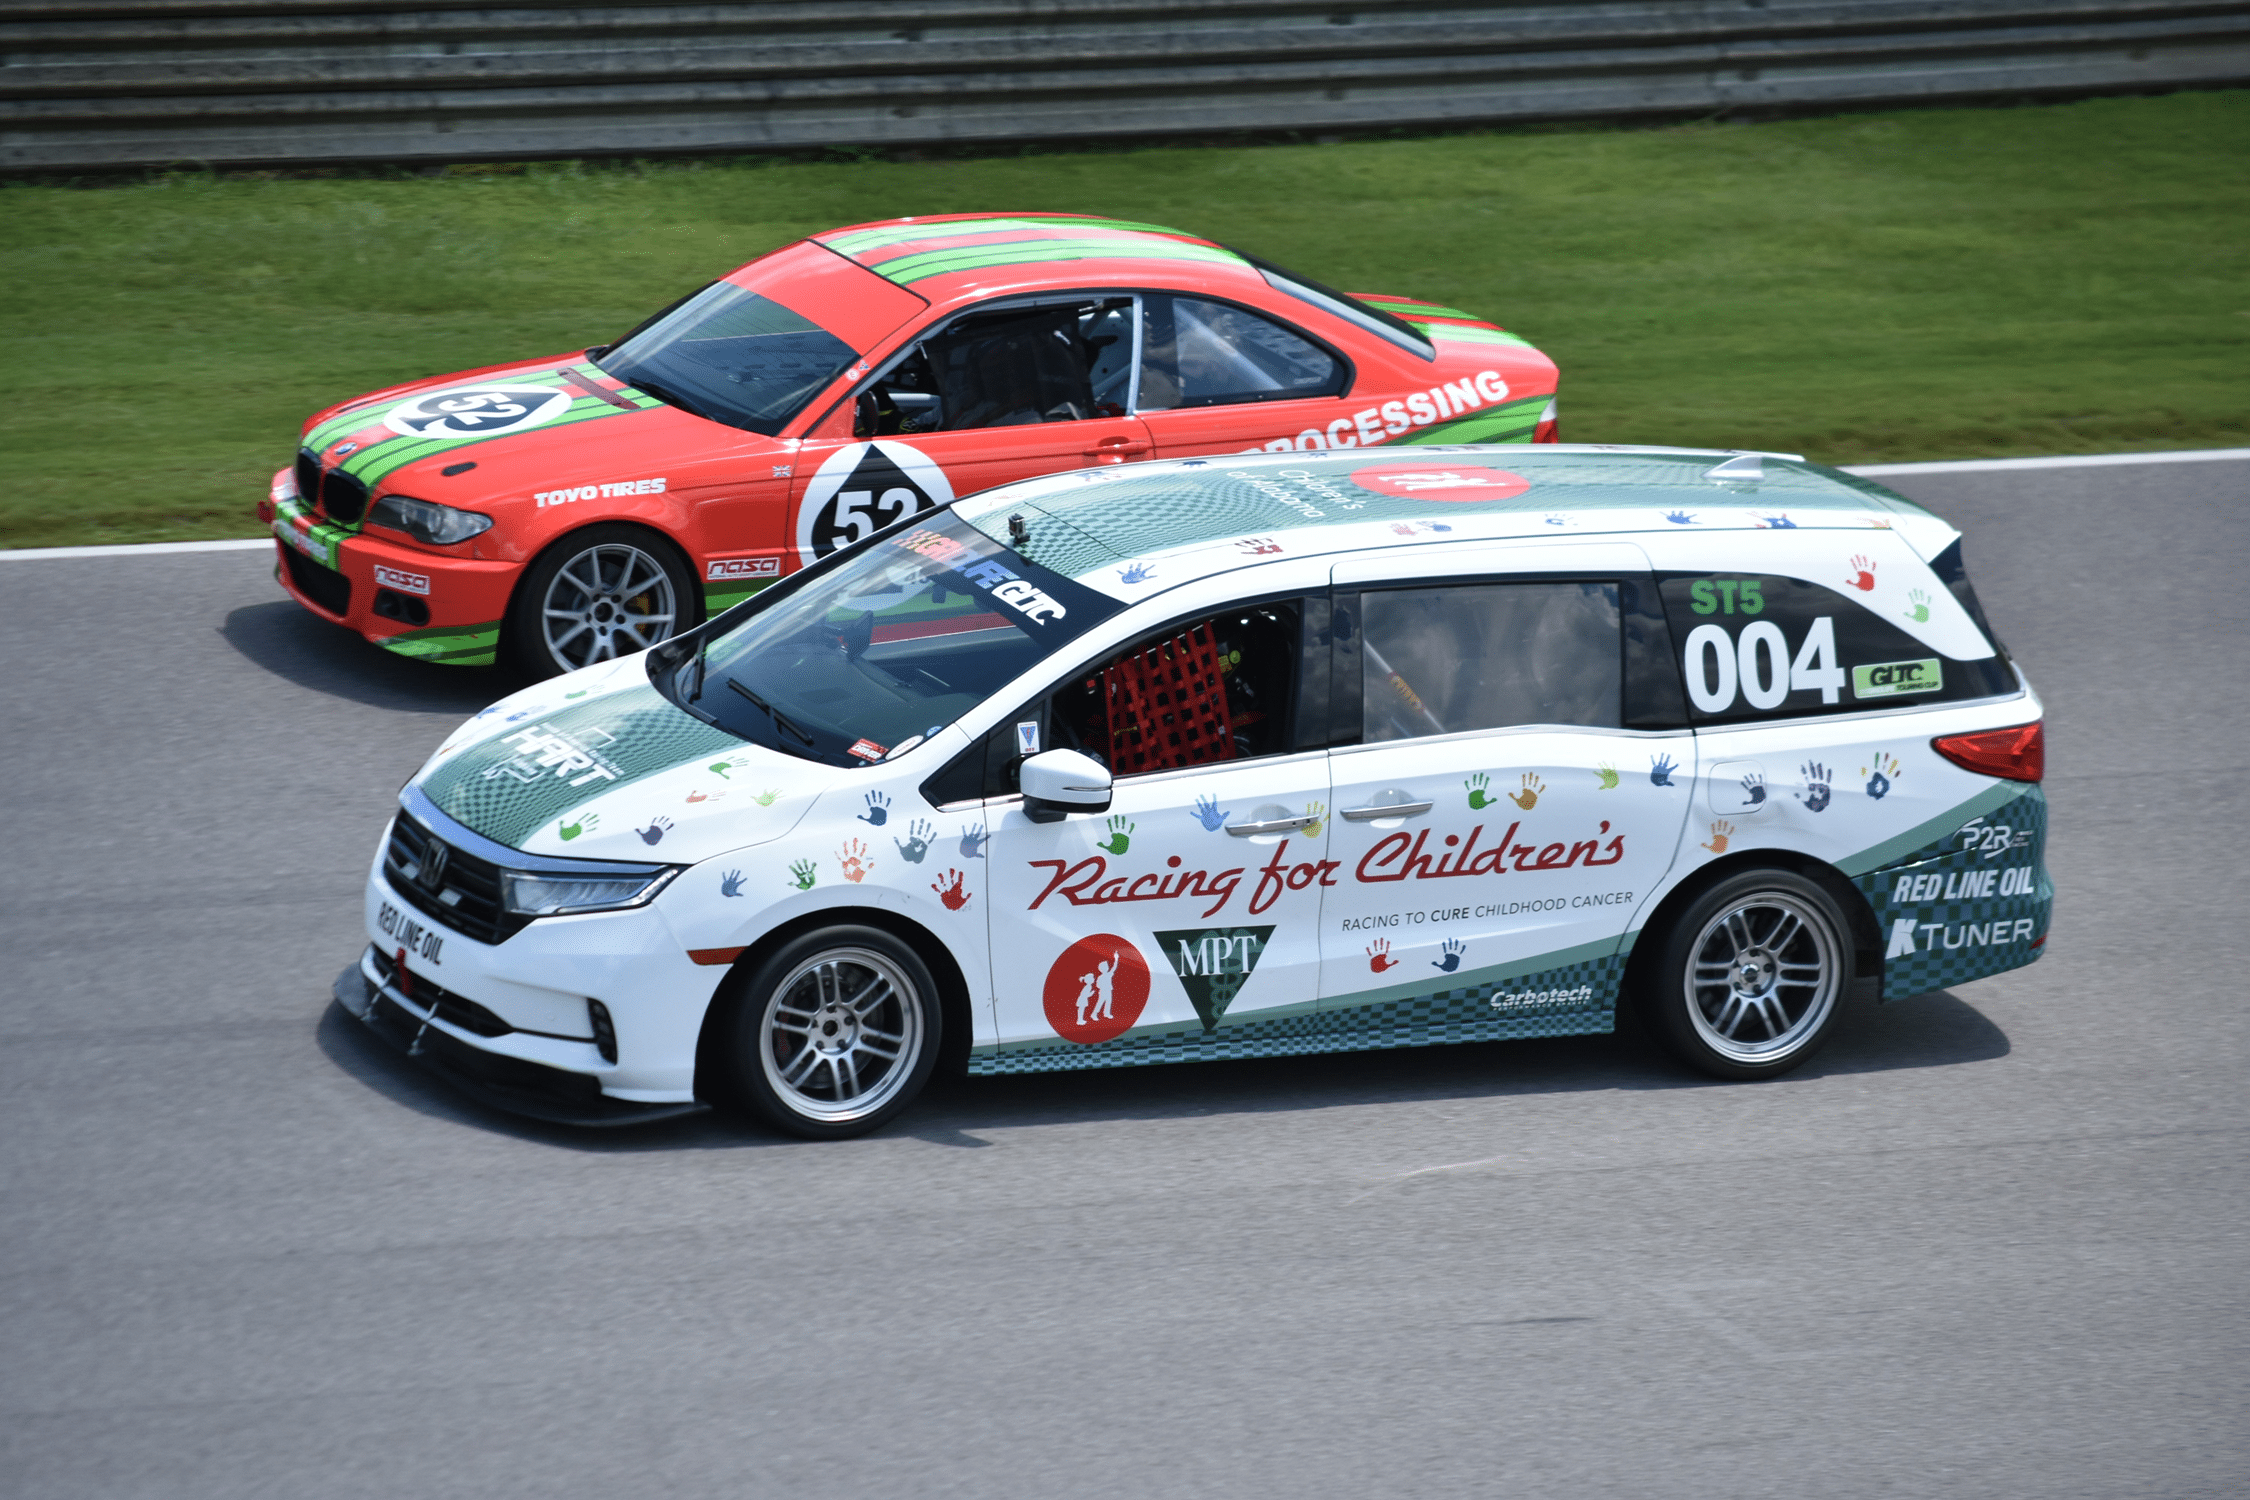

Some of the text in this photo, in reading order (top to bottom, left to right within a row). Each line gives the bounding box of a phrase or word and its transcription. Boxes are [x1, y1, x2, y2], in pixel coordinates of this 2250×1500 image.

[438, 392, 527, 425] 52
[534, 478, 667, 508] TOYO TIRES
[831, 487, 918, 551] 52
[707, 559, 778, 575] nasa
[991, 580, 1067, 626] GLTC
[1690, 579, 1765, 615] ST5
[1684, 616, 1846, 713] 004
[1869, 663, 1925, 686] GLTC
[1958, 825, 2011, 851] P2R
[1027, 820, 1626, 919] Racing for Children's
[1892, 866, 2034, 903] RED LINE OIL
[1342, 891, 1634, 931] RACING TO CURE CHILDHOOD CANCER
[421, 932, 444, 966] OIL
[1177, 935, 1257, 977] MPT
[1490, 985, 1593, 1007] Carbotech
